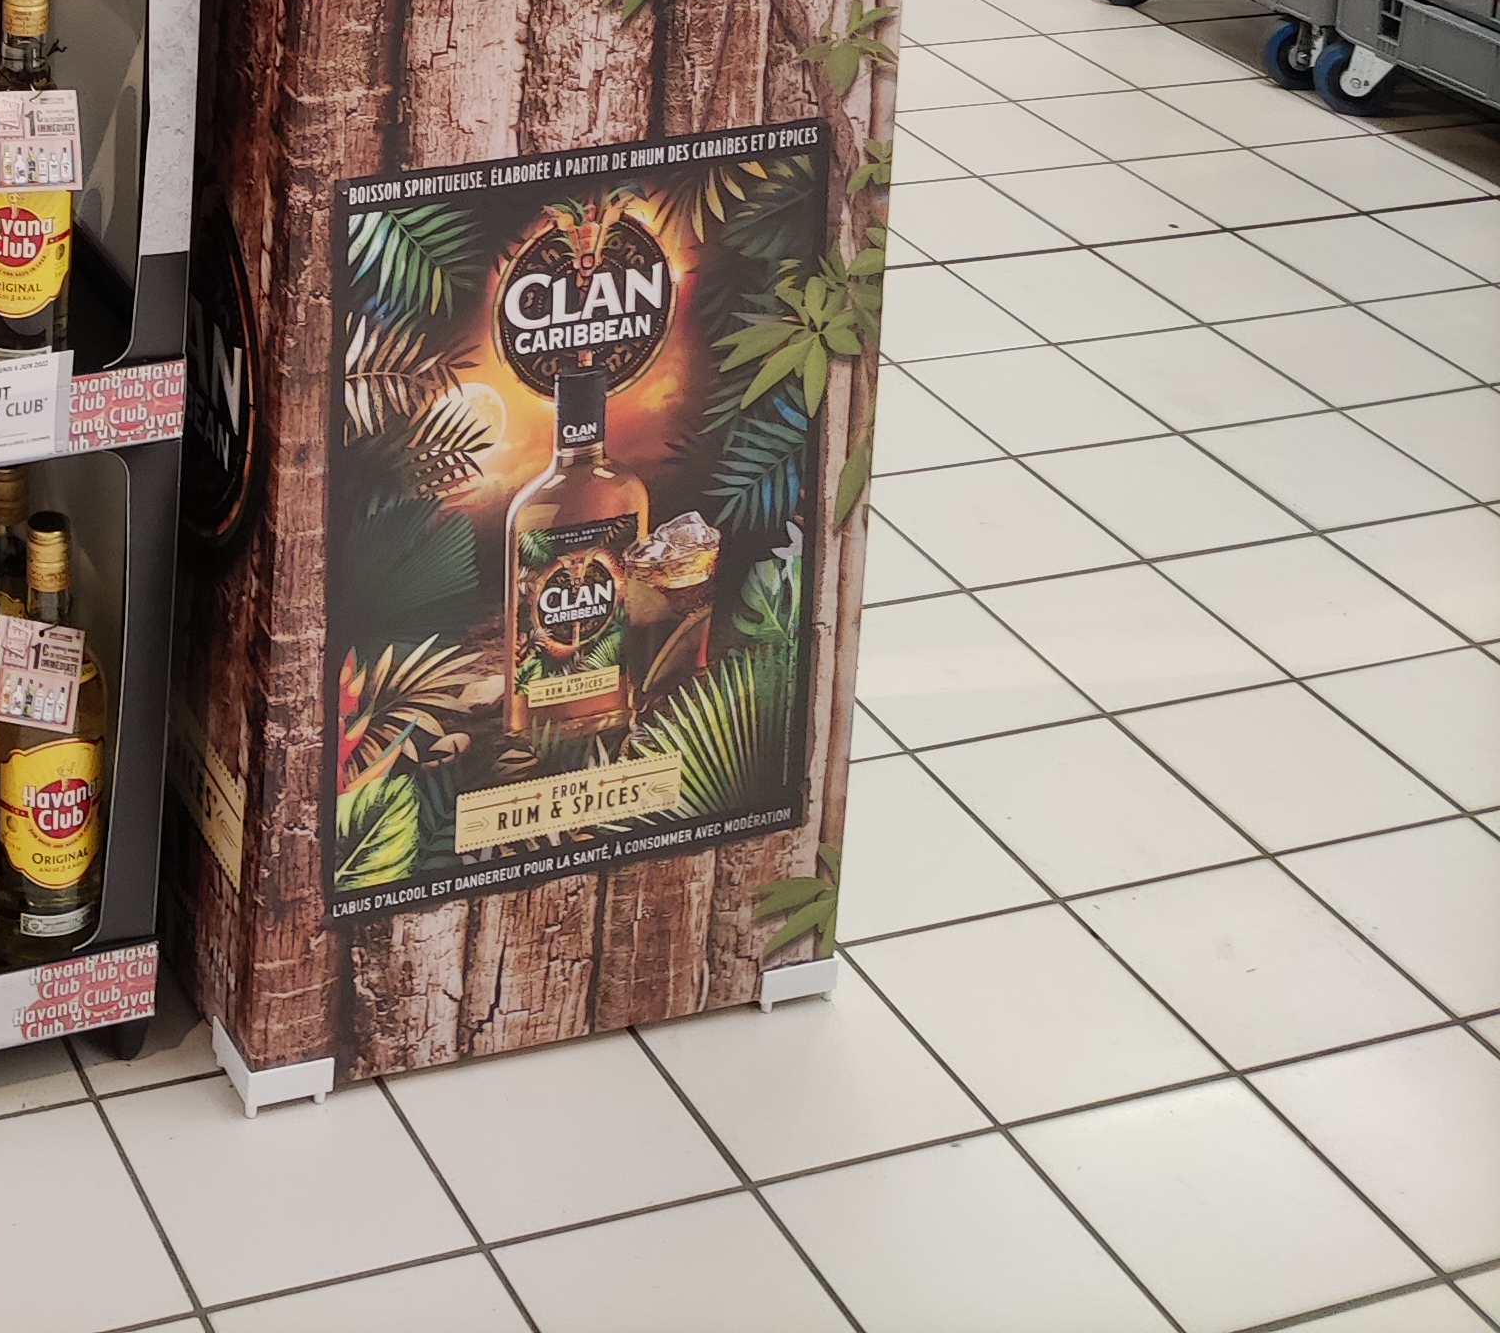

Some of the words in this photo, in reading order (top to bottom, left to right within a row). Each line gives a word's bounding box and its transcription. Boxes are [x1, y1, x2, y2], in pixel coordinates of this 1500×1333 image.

[491, 164, 550, 186] ÉLABORÉE
[554, 158, 563, 178] À
[566, 155, 608, 175] PARTIR
[612, 153, 626, 169] DE
[630, 146, 665, 168] RHUM
[668, 143, 689, 162] DES
[692, 136, 748, 160] CARAÏBES
[751, 134, 765, 152] ET
[504, 262, 665, 332] CLAN
[514, 314, 652, 356] CARIBBEAN
[562, 422, 597, 438] CLAN
[539, 581, 612, 613] CLAN
[544, 604, 607, 625] CARIBBEAN
[552, 780, 588, 800] FROM
[498, 806, 540, 830] RUM
[550, 800, 562, 818] &
[333, 895, 371, 918] L'ABUS
[375, 884, 428, 908] D'ALCOOL
[431, 879, 451, 895] EST
[455, 865, 521, 892] DANGEREUX
[524, 859, 554, 876] POUR
[557, 856, 570, 871] LA
[614, 840, 623, 857] À
[625, 828, 692, 854] CONSOMMER
[695, 820, 722, 840] AVEC
[724, 807, 791, 836] MODÉRATION
